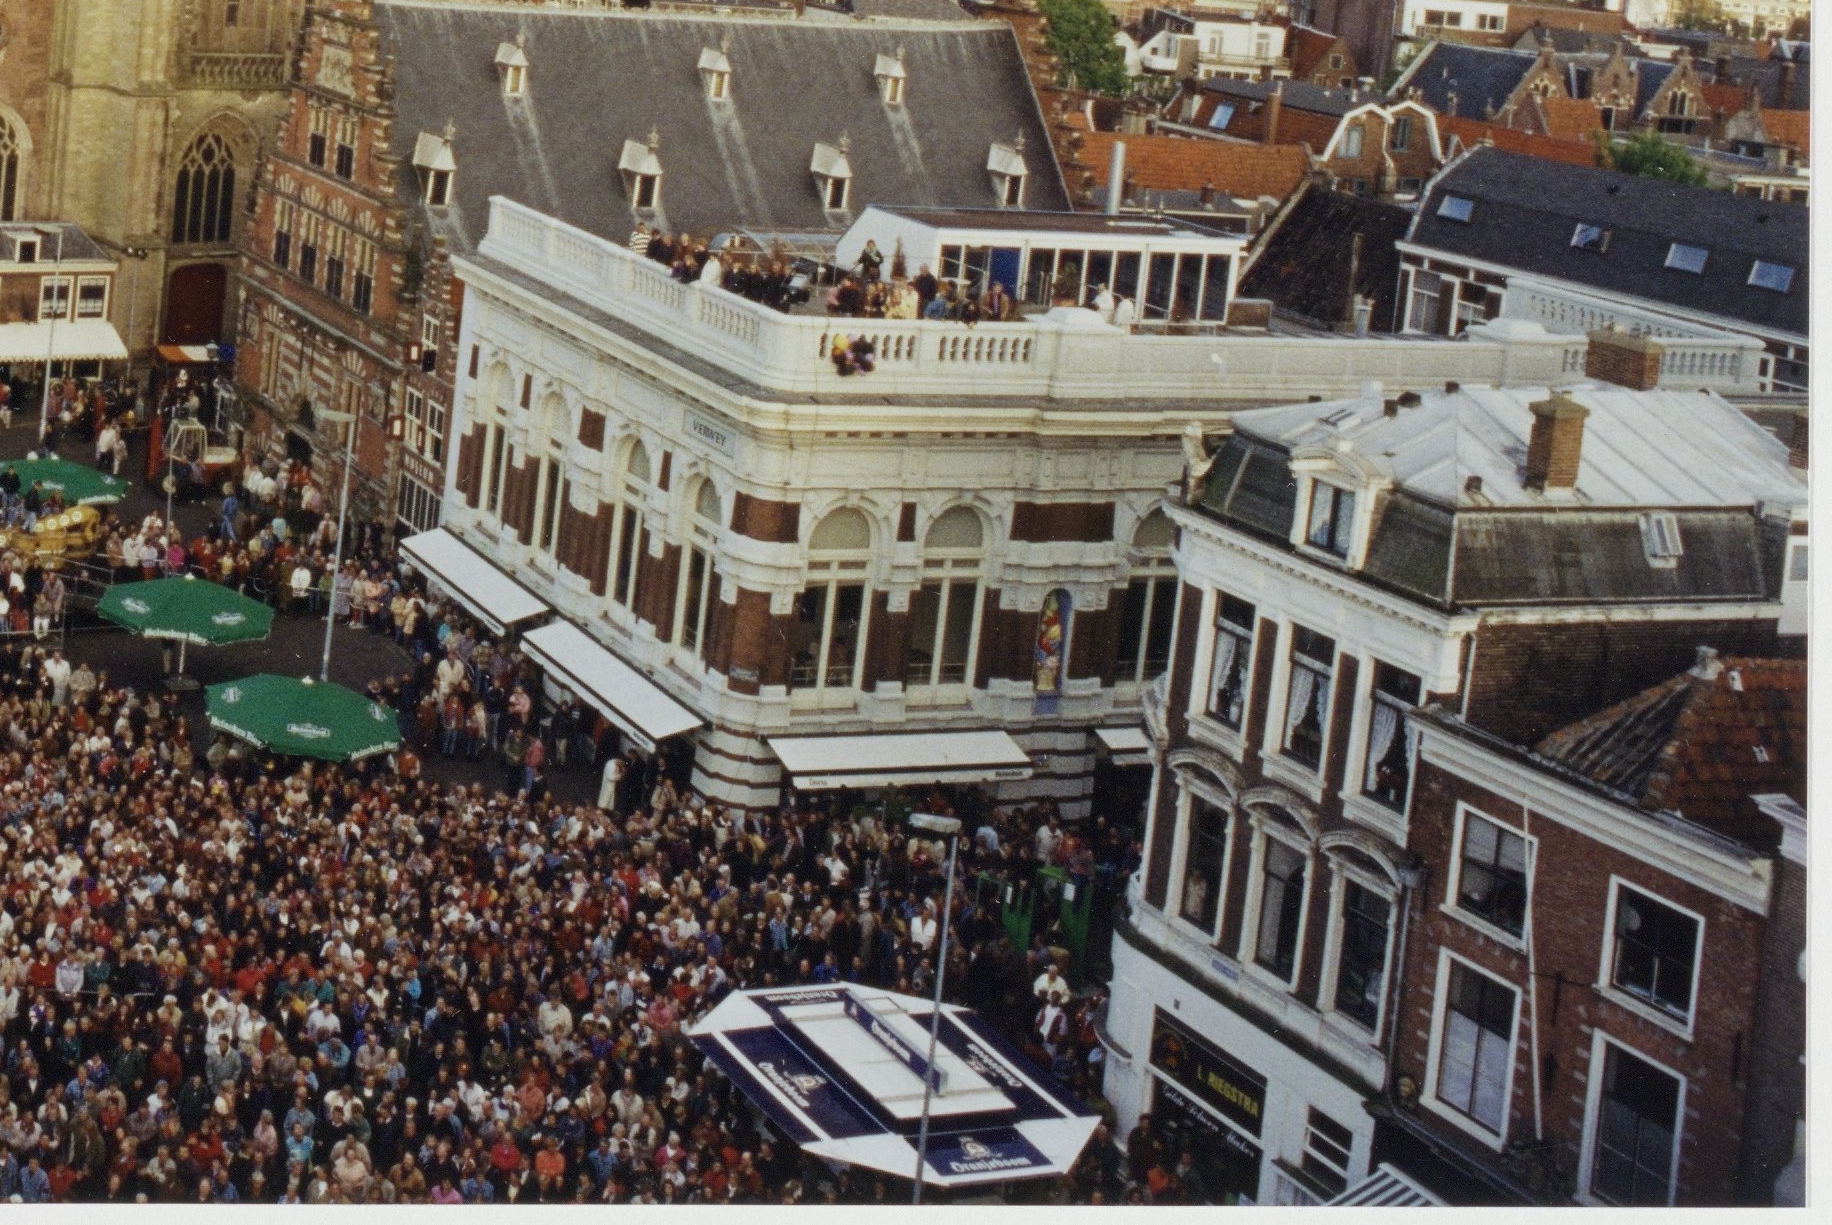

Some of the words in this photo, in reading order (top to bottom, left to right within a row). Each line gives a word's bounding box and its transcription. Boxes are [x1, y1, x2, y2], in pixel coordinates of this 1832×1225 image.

[693, 419, 726, 446] VERWEY
[871, 1019, 912, 1063] Oranjeboom
[757, 1061, 811, 1108] Oranjeboom
[949, 1156, 1032, 1173] Oranjeboom
